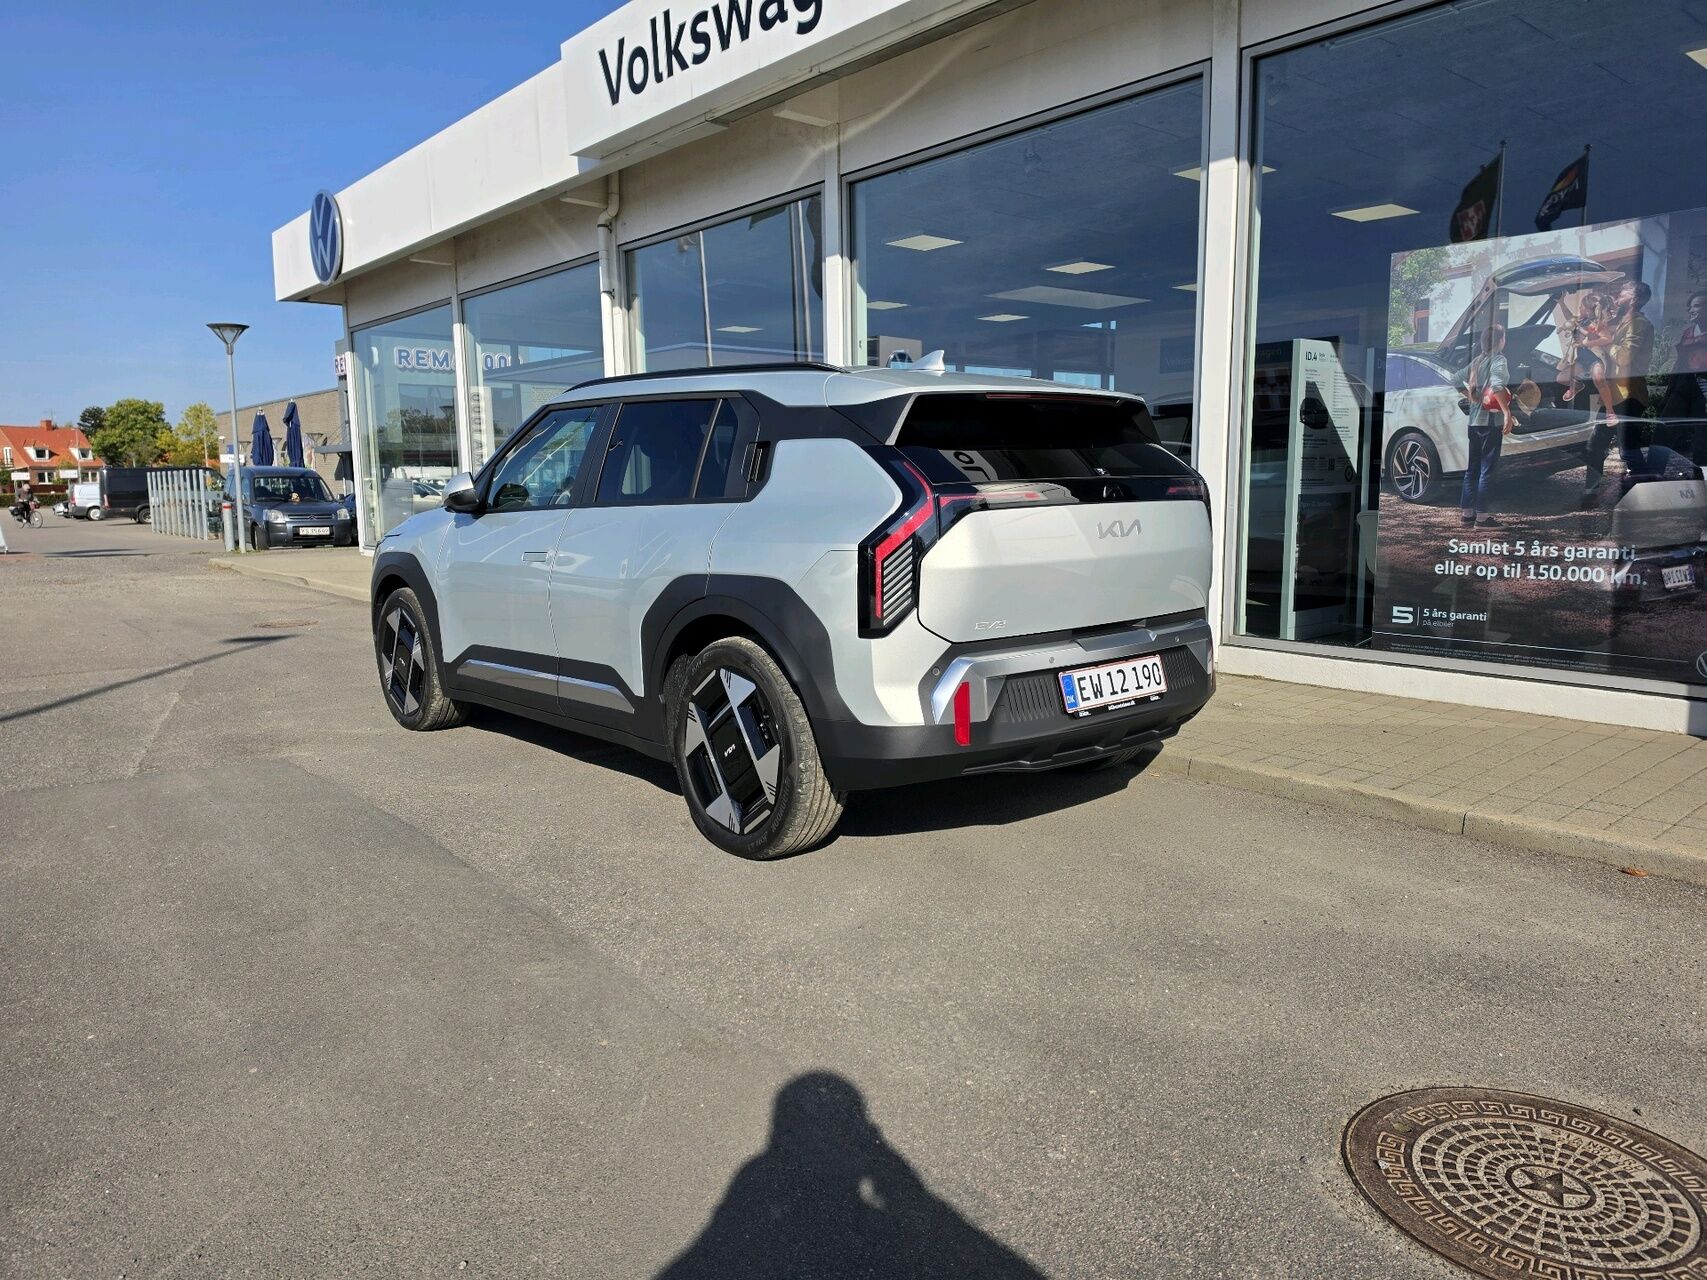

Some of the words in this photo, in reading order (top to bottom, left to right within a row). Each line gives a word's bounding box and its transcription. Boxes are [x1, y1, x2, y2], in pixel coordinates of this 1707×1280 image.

[395, 347, 454, 370] REM
[1096, 519, 1143, 540] KIA
[1448, 538, 1509, 556] Samlet
[1514, 541, 1525, 557] 5
[1530, 540, 1558, 557] års
[1564, 544, 1636, 561] garanti
[1434, 560, 1472, 576] eller
[1476, 564, 1498, 579] op
[1503, 562, 1521, 579] til
[1527, 564, 1605, 583] 150.000
[1610, 566, 1648, 586] km.
[1392, 606, 1414, 624] 5
[1423, 608, 1430, 617] 5
[1431, 608, 1448, 619] års
[1449, 612, 1488, 621] garanti
[1076, 673, 1104, 702] EW
[1106, 668, 1130, 696] 12
[1131, 662, 1163, 691] 190
[1066, 694, 1076, 705] DK
